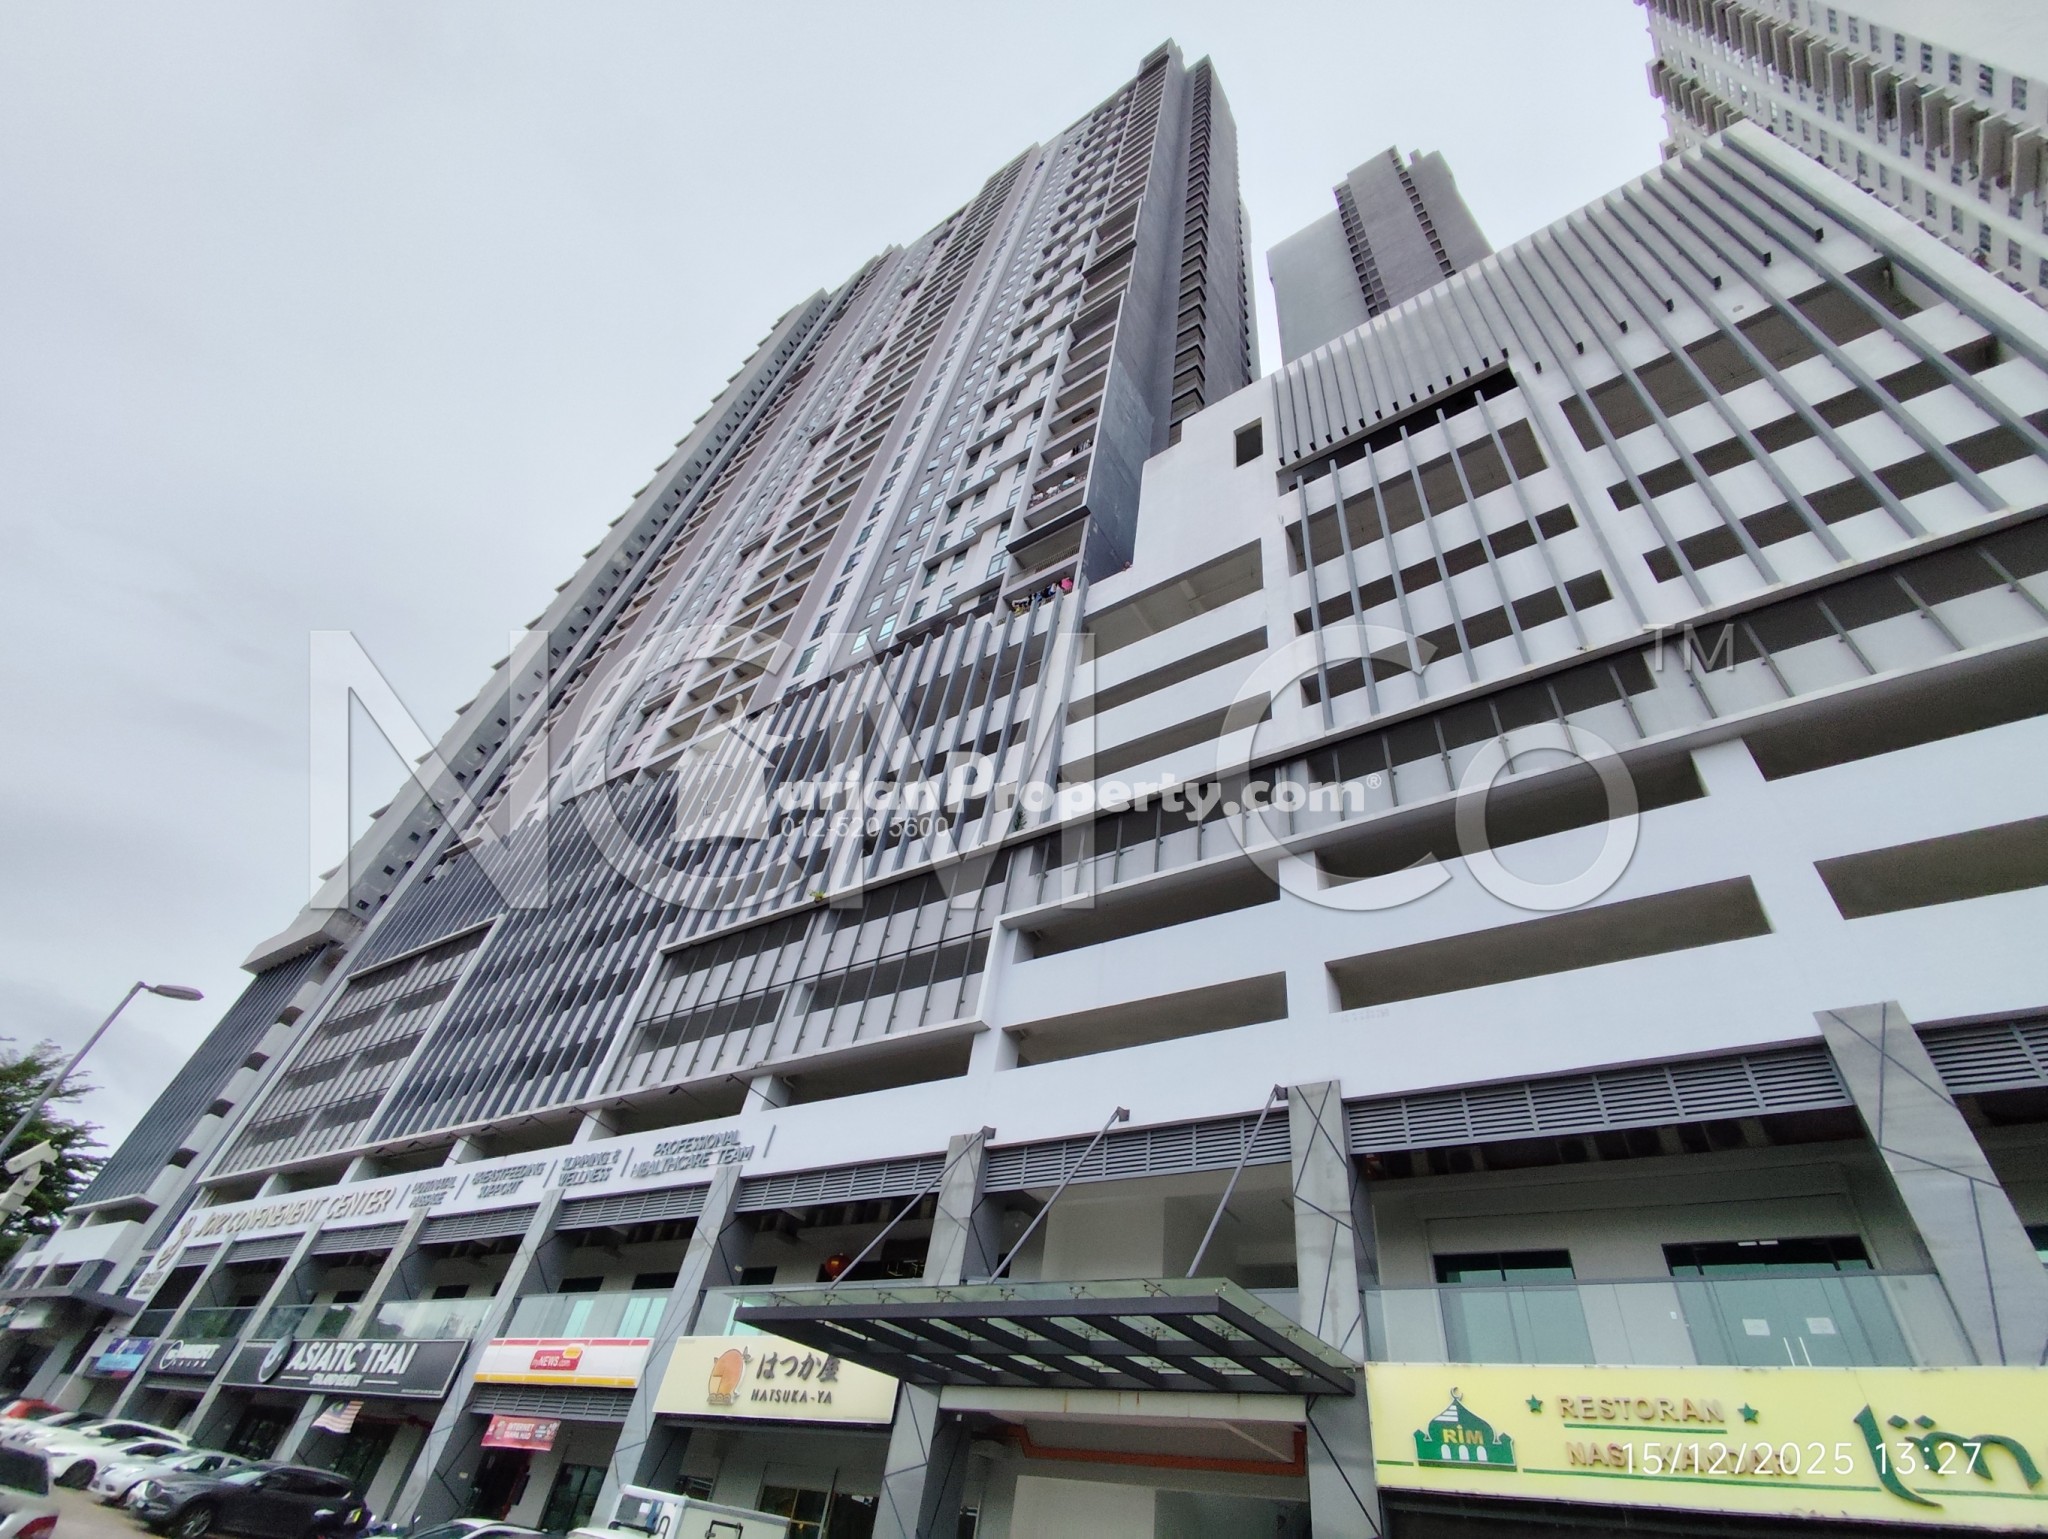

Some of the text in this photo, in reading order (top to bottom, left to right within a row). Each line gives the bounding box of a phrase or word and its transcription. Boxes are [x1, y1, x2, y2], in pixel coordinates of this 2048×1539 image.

[653, 1129, 741, 1157] PROFESSIONAL
[471, 1162, 548, 1186] BREASTFEEDING
[631, 1145, 756, 1179] HEALTHCARE TEAM
[477, 1180, 524, 1199] SUPPORT
[558, 1167, 614, 1187] WELLNESS
[226, 1197, 330, 1234] CONFINEMENT
[326, 1187, 397, 1220] CENTER
[284, 1341, 419, 1375] ASIATIC THAI
[756, 1351, 841, 1383] はつか屋
[1557, 1396, 1727, 1424] RESTORAN
